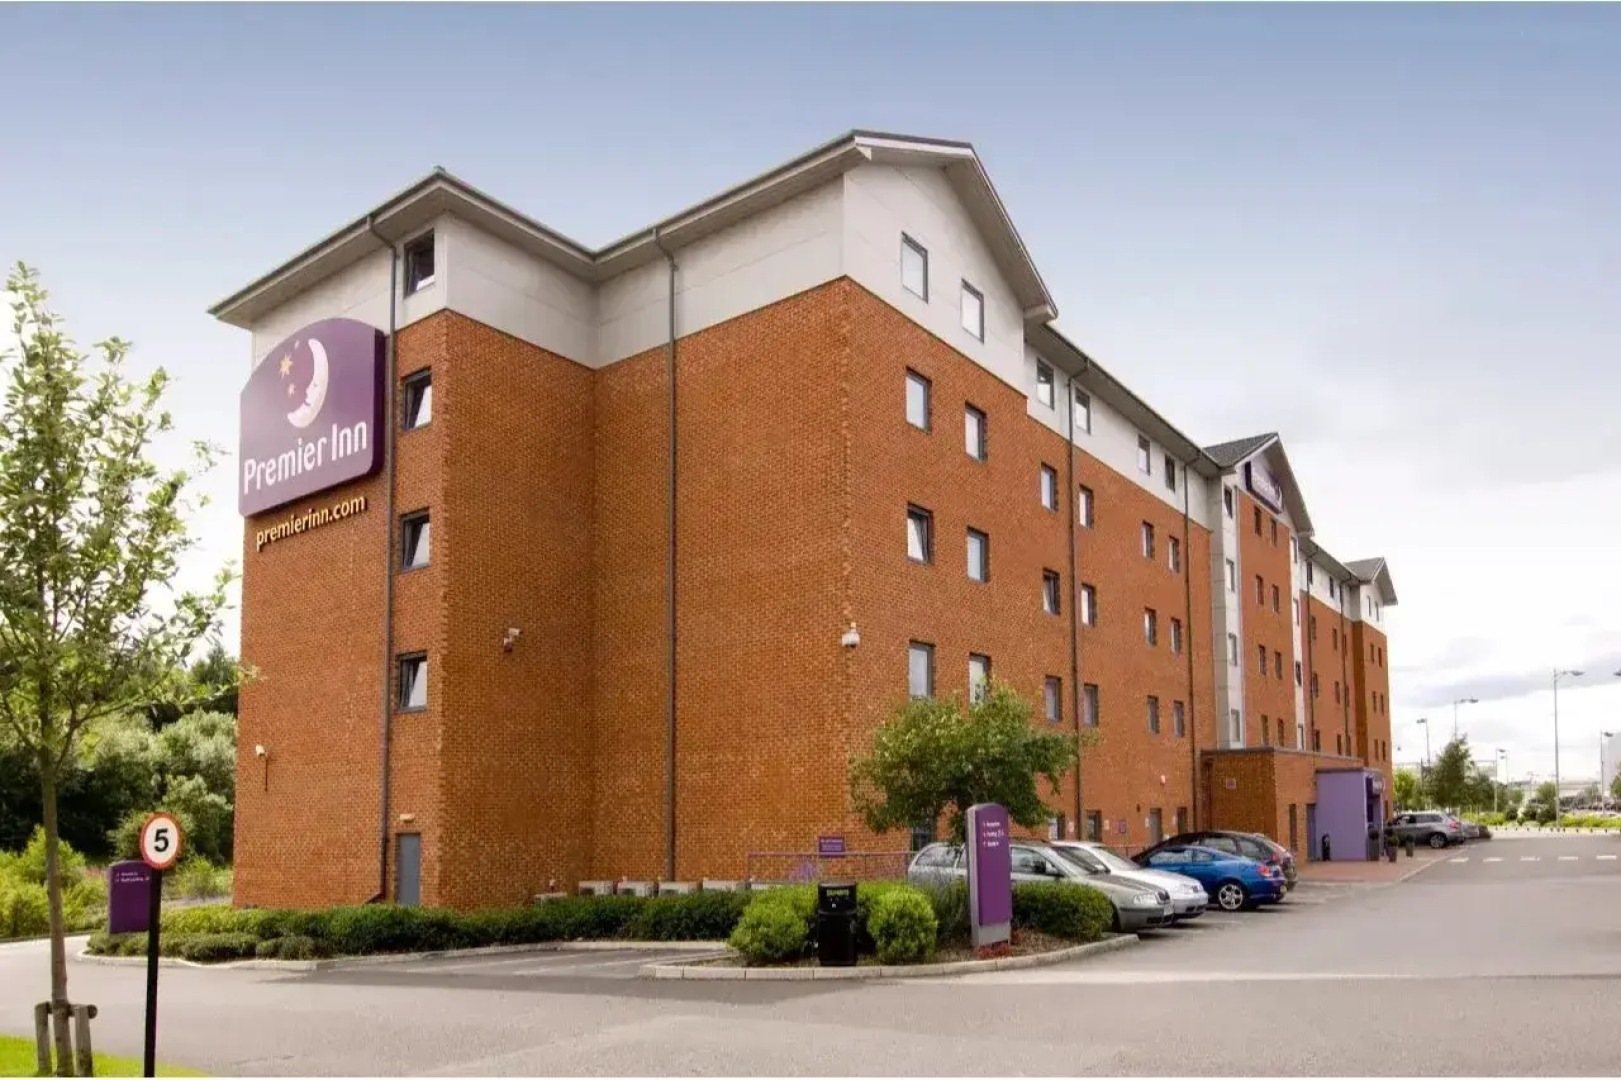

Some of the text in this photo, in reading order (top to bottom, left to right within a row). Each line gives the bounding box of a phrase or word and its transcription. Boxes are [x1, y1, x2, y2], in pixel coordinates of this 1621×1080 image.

[243, 421, 367, 495] Premier Inn
[256, 495, 367, 552] premierinn.com
[154, 828, 169, 852] 5
